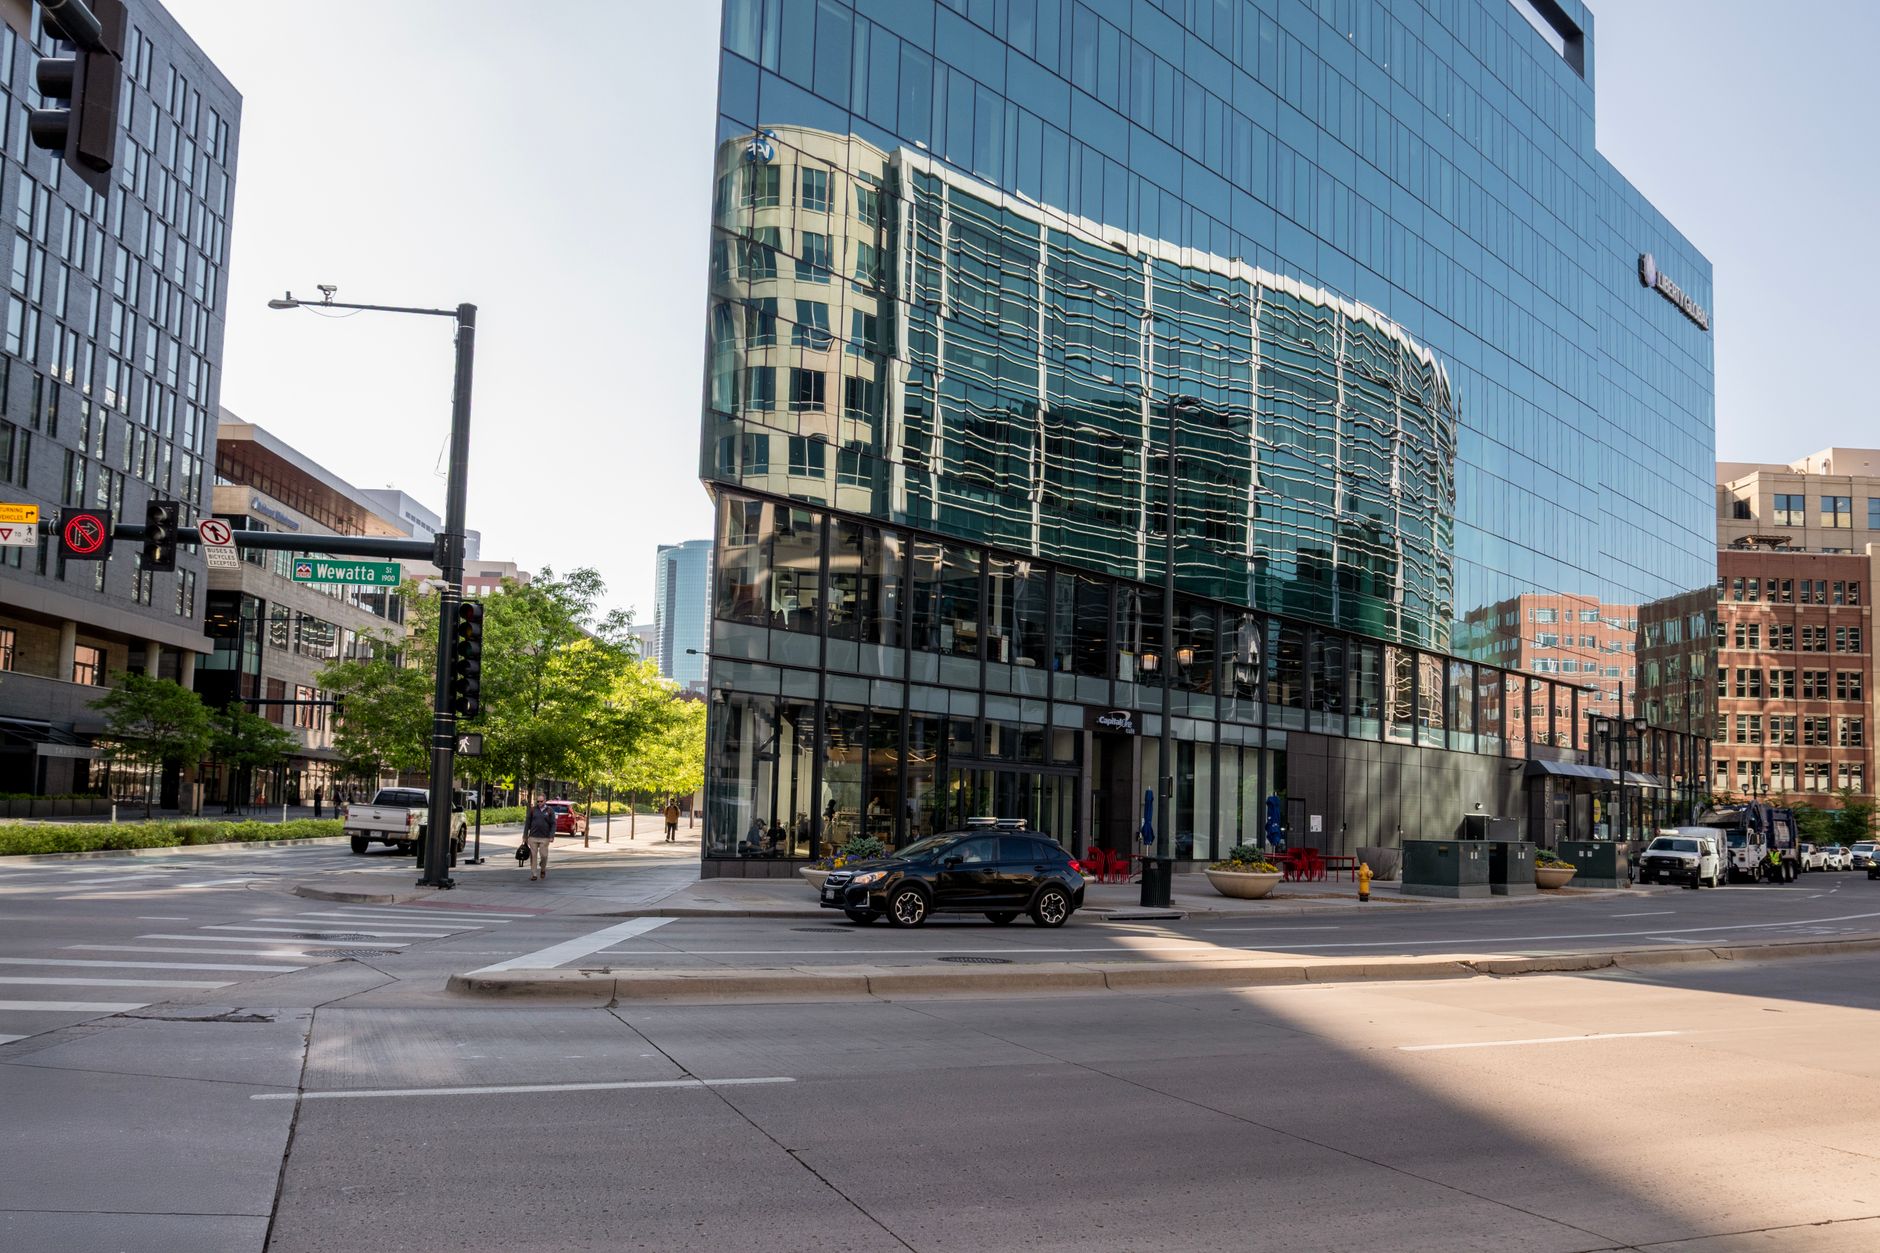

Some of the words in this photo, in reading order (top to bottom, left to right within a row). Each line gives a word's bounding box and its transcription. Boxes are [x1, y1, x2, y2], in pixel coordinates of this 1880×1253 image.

[1656, 271, 1684, 307] LIBERTY
[1684, 295, 1709, 330] GLOBAL
[208, 553, 236, 561] BICYCLES
[316, 563, 375, 581] Wewatta
[385, 566, 393, 574] St
[381, 574, 396, 582] 1900
